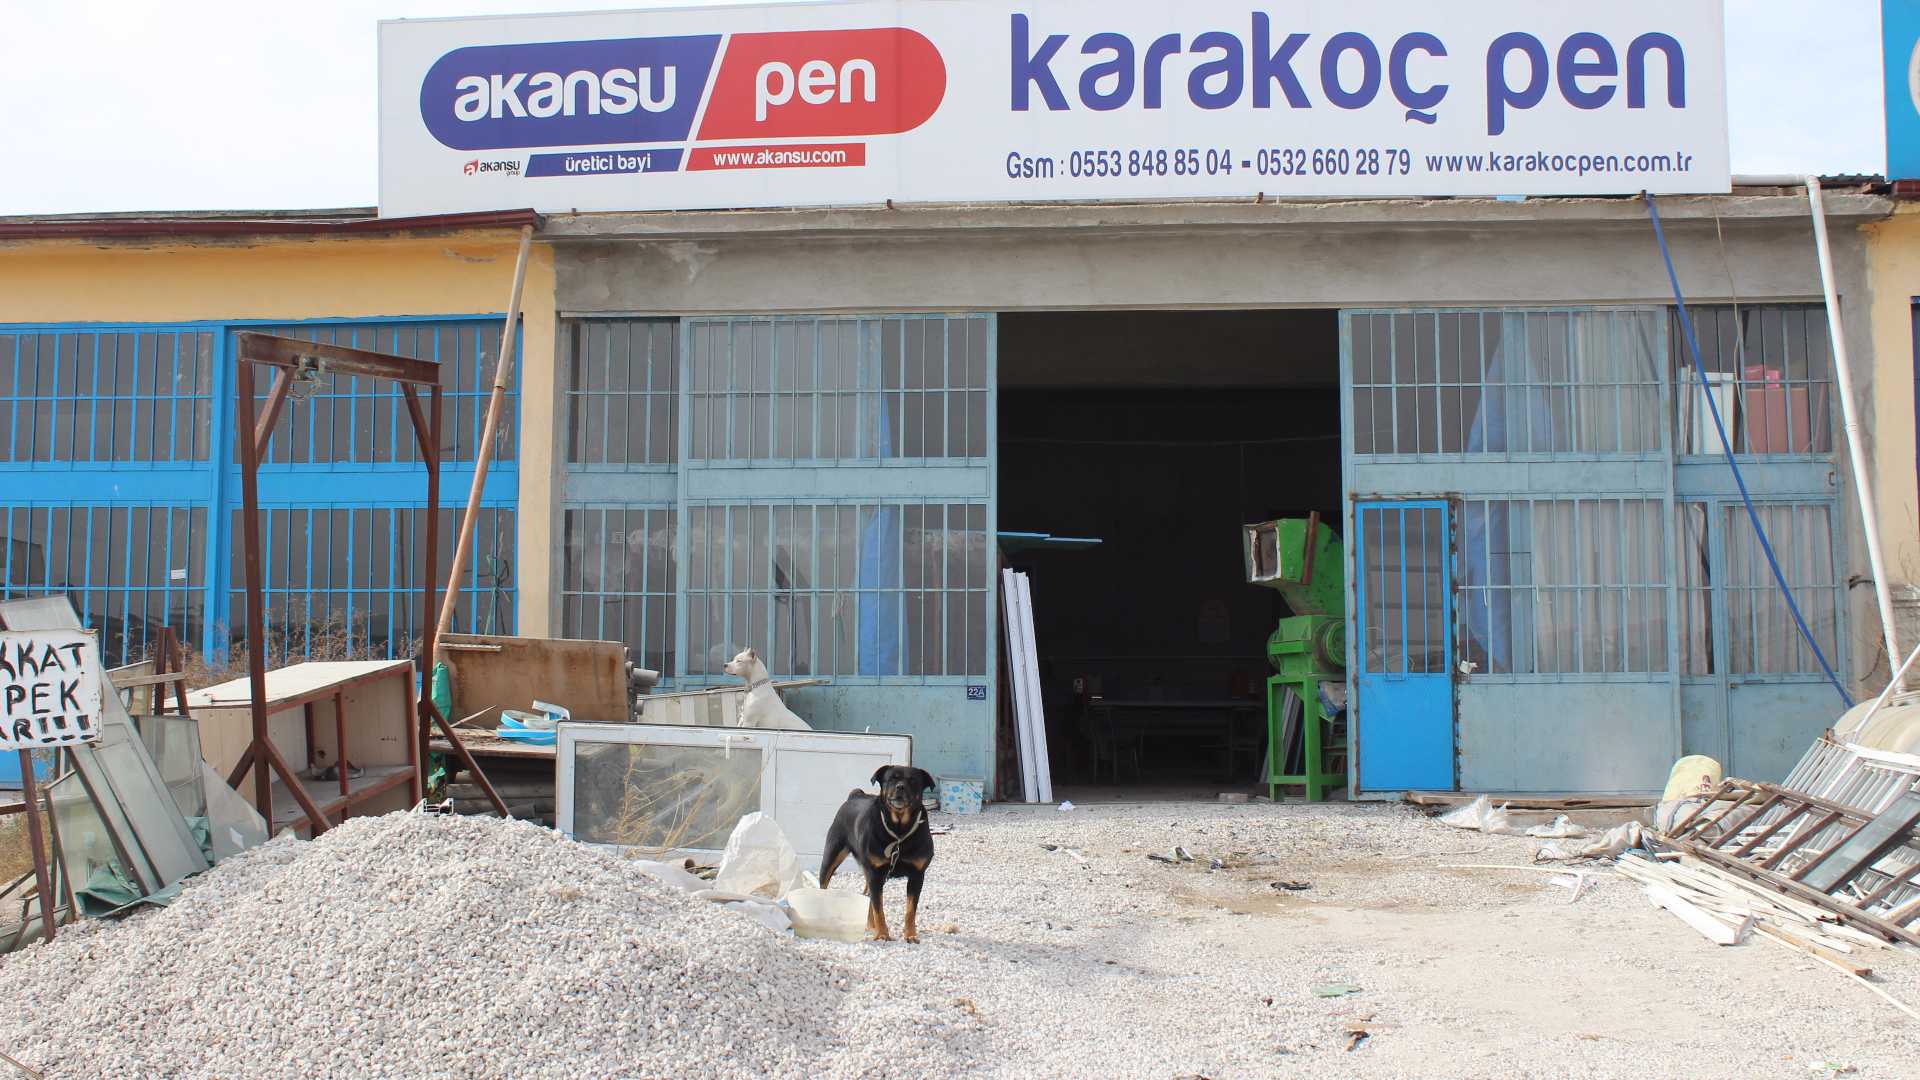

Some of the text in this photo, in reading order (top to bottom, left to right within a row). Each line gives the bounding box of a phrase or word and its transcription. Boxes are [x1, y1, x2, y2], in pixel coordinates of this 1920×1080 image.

[1010, 11, 1686, 136] karakoç pen
[755, 59, 877, 122] pen
[565, 153, 651, 173] üretici bayi
[713, 149, 847, 166] www.akansu.com
[1006, 151, 1054, 179] Gsm
[1069, 150, 1122, 178] 0553
[1128, 149, 1168, 177] 848
[1174, 149, 1200, 176] 85
[1206, 148, 1233, 176] 04
[1256, 148, 1307, 176] 0532
[1312, 148, 1350, 176] 660
[1355, 148, 1380, 176] 28
[1385, 148, 1411, 176] 79
[1425, 151, 1692, 176] www.karakocpen.com.tr
[968, 687, 985, 698] 22A
